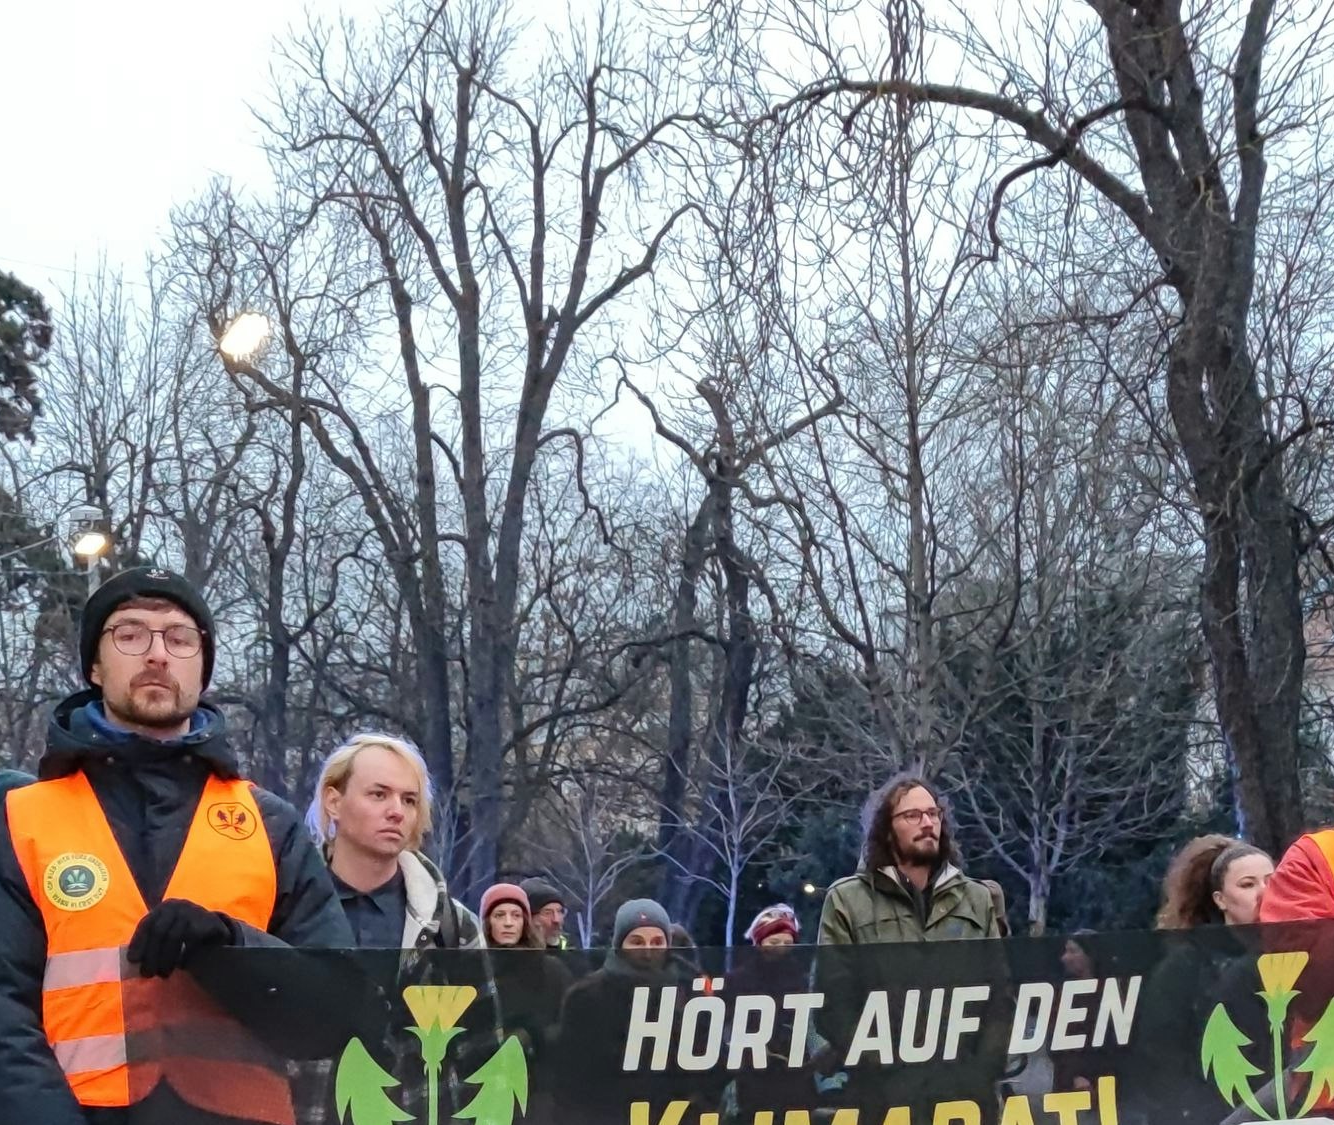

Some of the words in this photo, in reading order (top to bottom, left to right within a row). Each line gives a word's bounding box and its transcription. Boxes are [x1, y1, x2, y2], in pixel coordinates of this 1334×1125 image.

[622, 977, 825, 1071] HÖRT
[844, 985, 990, 1066] AUF
[1008, 975, 1142, 1054] DEN
